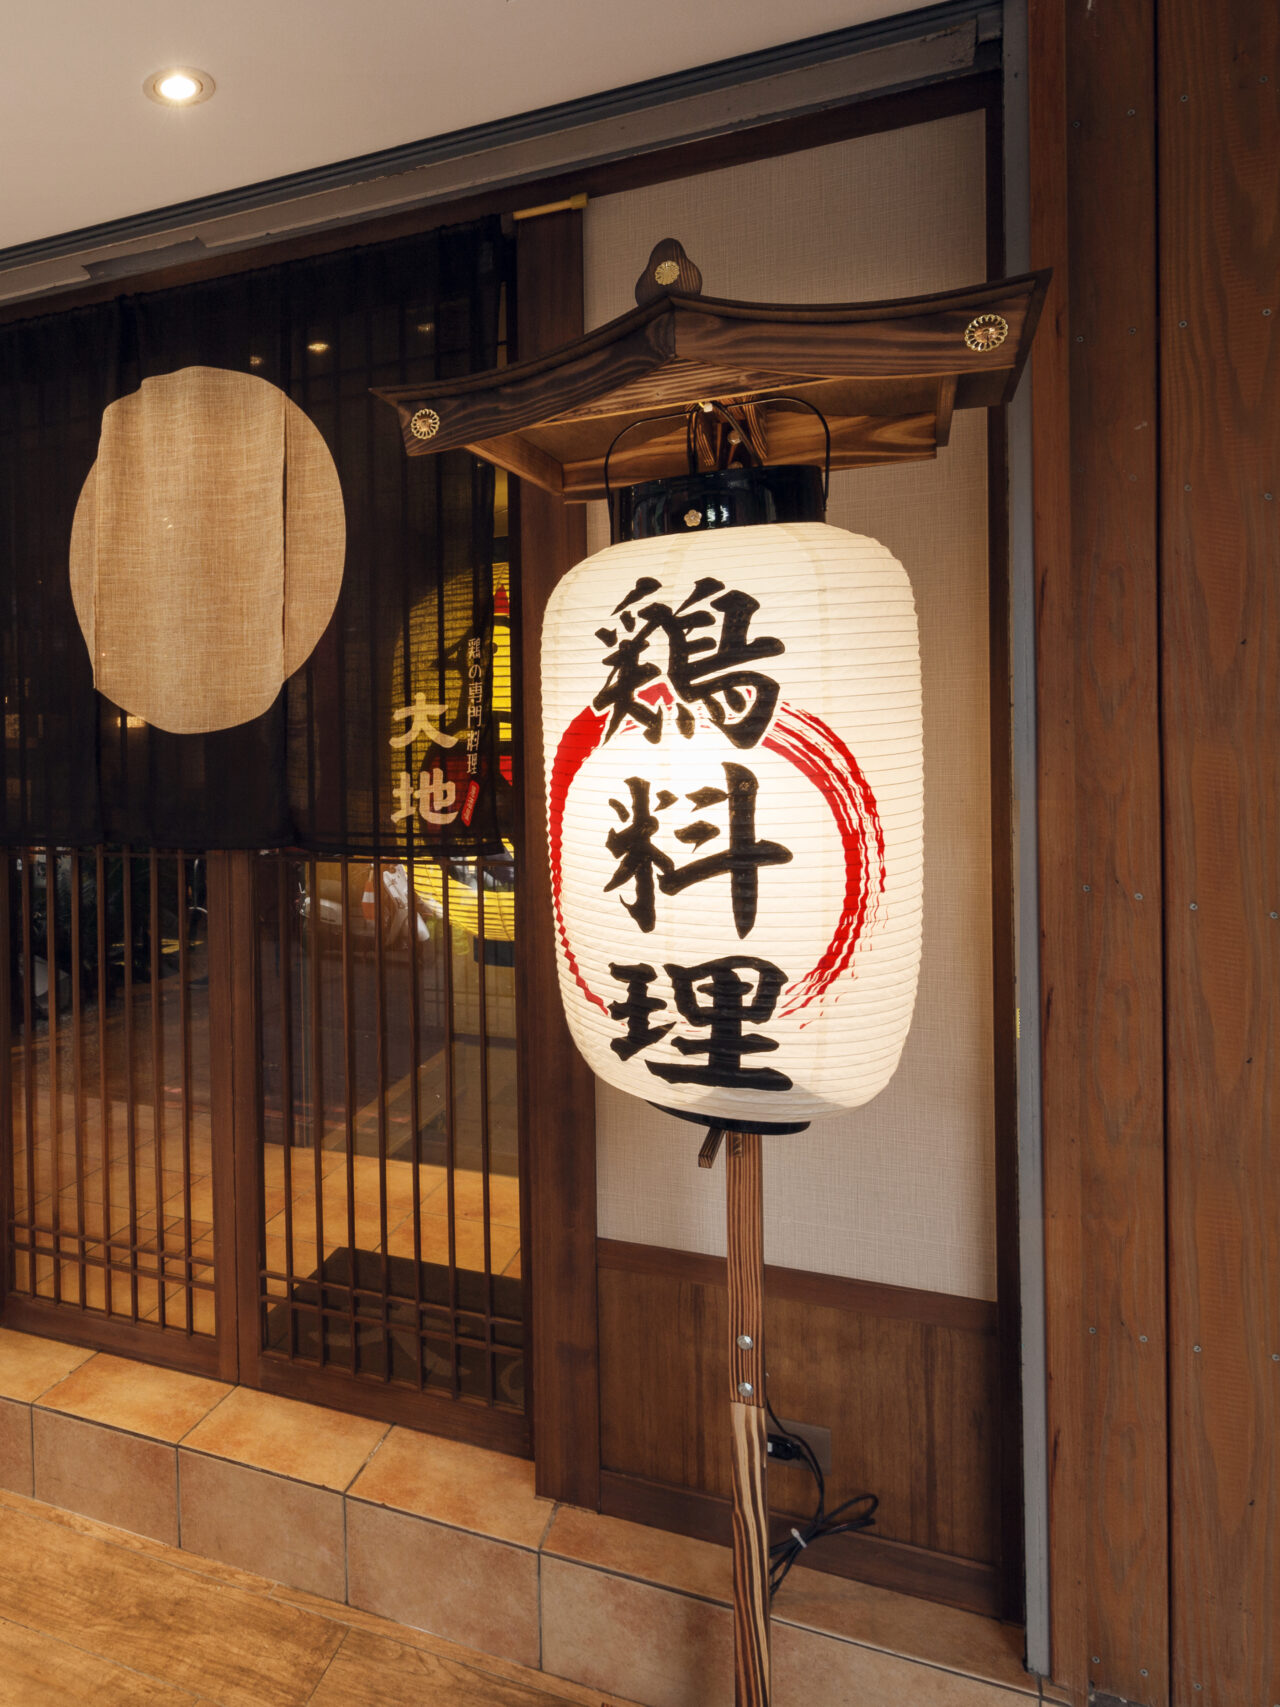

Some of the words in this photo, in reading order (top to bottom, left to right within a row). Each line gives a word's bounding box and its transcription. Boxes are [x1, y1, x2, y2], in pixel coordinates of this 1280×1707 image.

[389, 691, 459, 825] 大地
[593, 576, 793, 1091] 鶏料理
